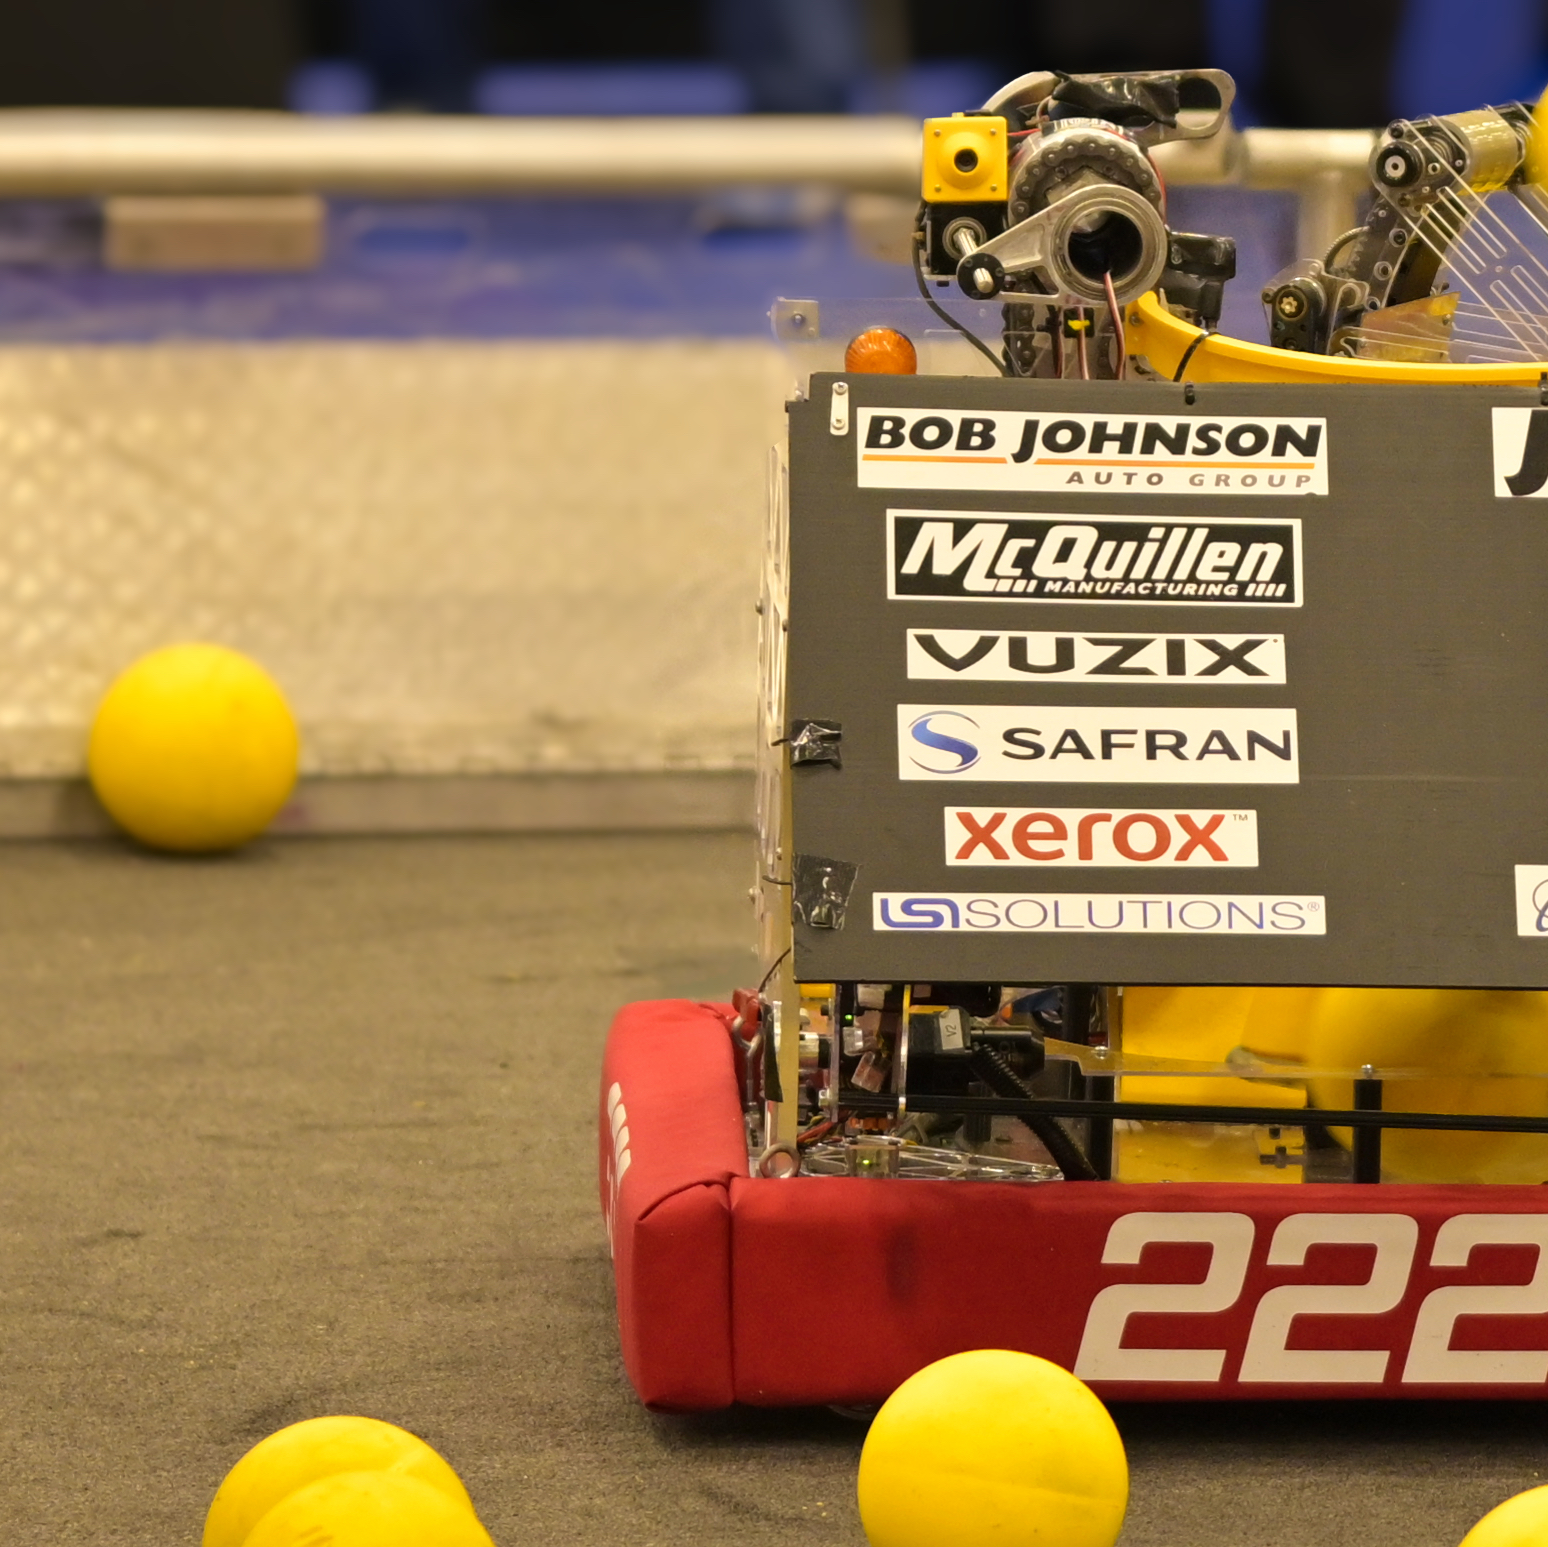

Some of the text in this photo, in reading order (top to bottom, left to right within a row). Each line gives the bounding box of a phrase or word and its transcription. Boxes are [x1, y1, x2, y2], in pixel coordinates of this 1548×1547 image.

[865, 414, 1322, 463] BOB JOHNSON
[1065, 471, 1311, 488] AUTO GROUP
[900, 520, 1284, 592] McQuillen
[1043, 579, 1239, 598] MANUFACTURING
[913, 633, 1271, 677] VUZIX
[1001, 728, 1292, 761] SAFRAN
